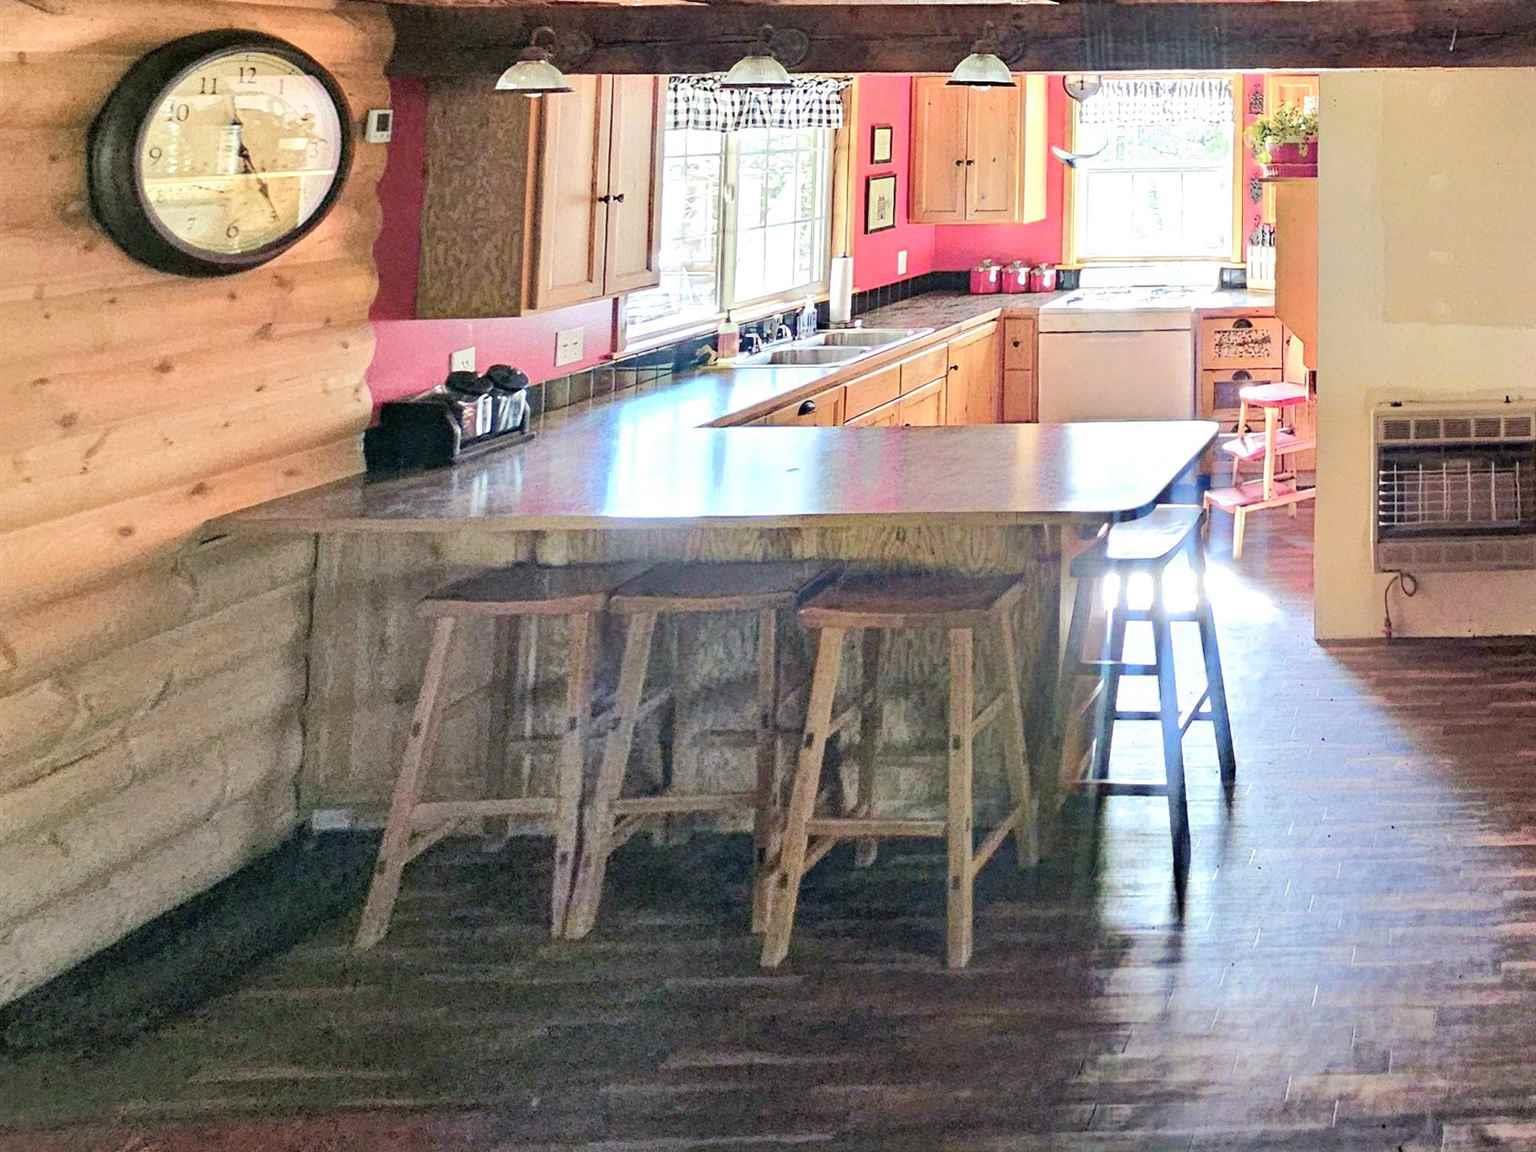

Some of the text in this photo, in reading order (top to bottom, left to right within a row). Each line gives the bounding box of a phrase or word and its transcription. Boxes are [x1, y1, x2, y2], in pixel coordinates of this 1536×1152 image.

[238, 66, 257, 84] 12
[199, 77, 218, 95] 11
[278, 78, 285, 95] 1
[166, 103, 190, 122] 10
[149, 147, 162, 167] 9
[225, 218, 241, 239] 6
